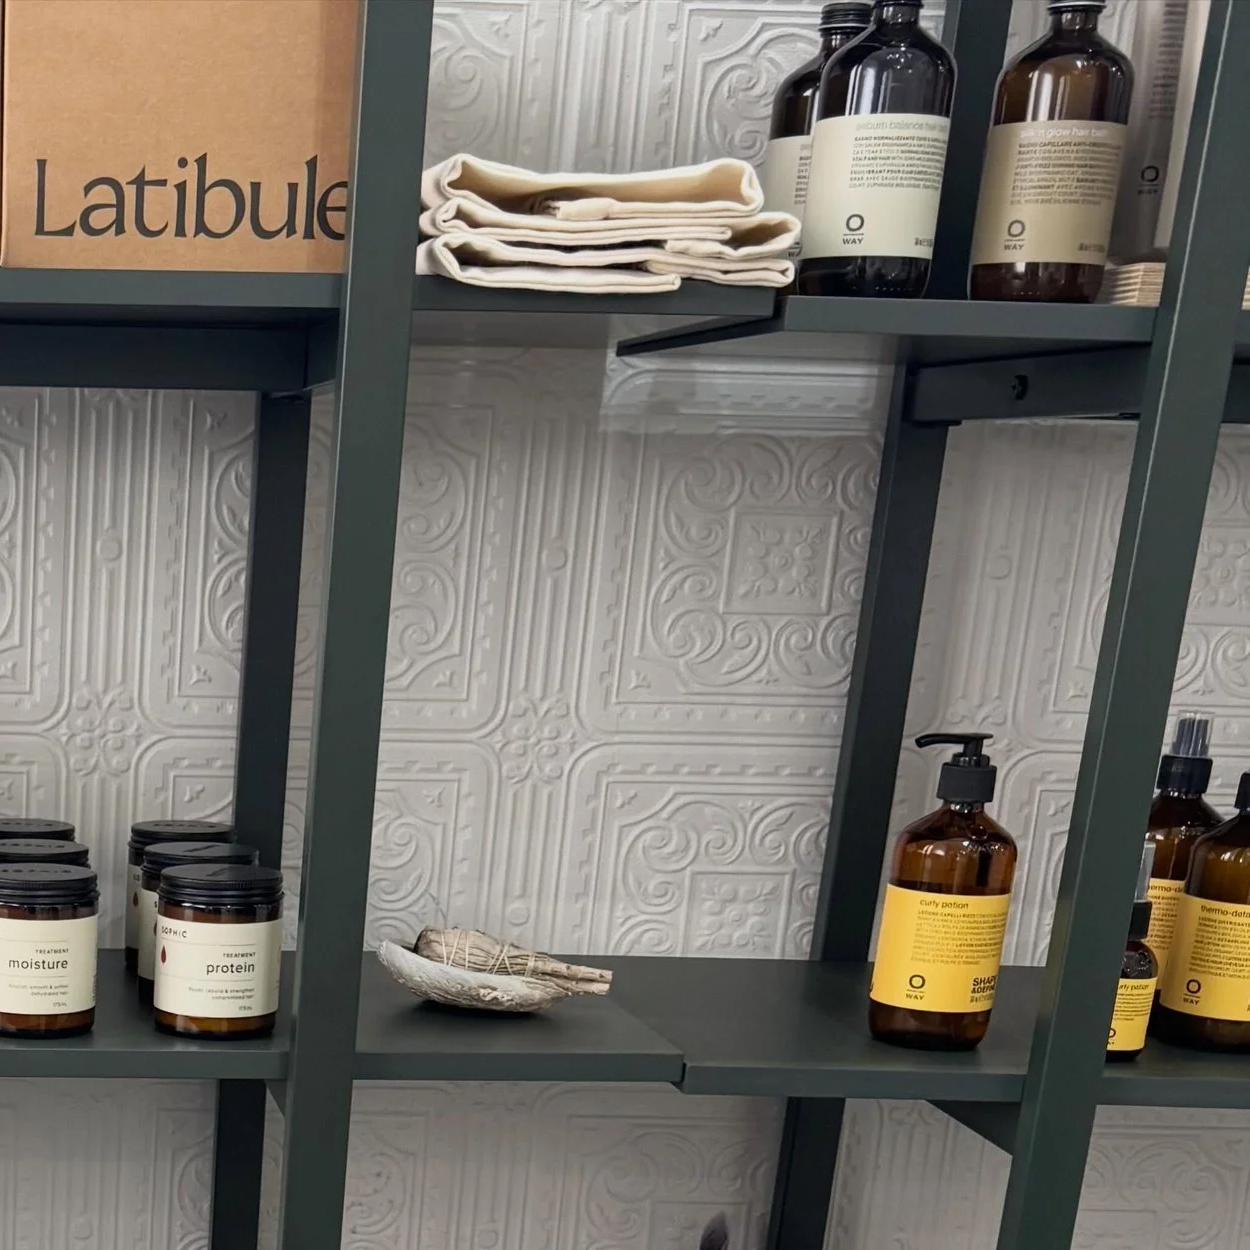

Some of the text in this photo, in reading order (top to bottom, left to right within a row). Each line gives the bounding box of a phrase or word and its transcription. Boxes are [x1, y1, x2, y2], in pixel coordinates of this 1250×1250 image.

[1141, 165, 1159, 182] O
[34, 152, 349, 241] Latibule
[845, 213, 865, 232] O
[1007, 219, 1026, 238] O
[842, 237, 864, 245] WAY
[1004, 243, 1025, 251] WAY
[919, 899, 969, 909] curly potion
[161, 926, 187, 938] SOPHIC
[8, 957, 68, 970] moisture
[206, 961, 255, 976] protein
[908, 974, 926, 989] O
[1186, 979, 1201, 994] O
[905, 993, 925, 1001] WAY
[1183, 997, 1200, 1006] WAY
